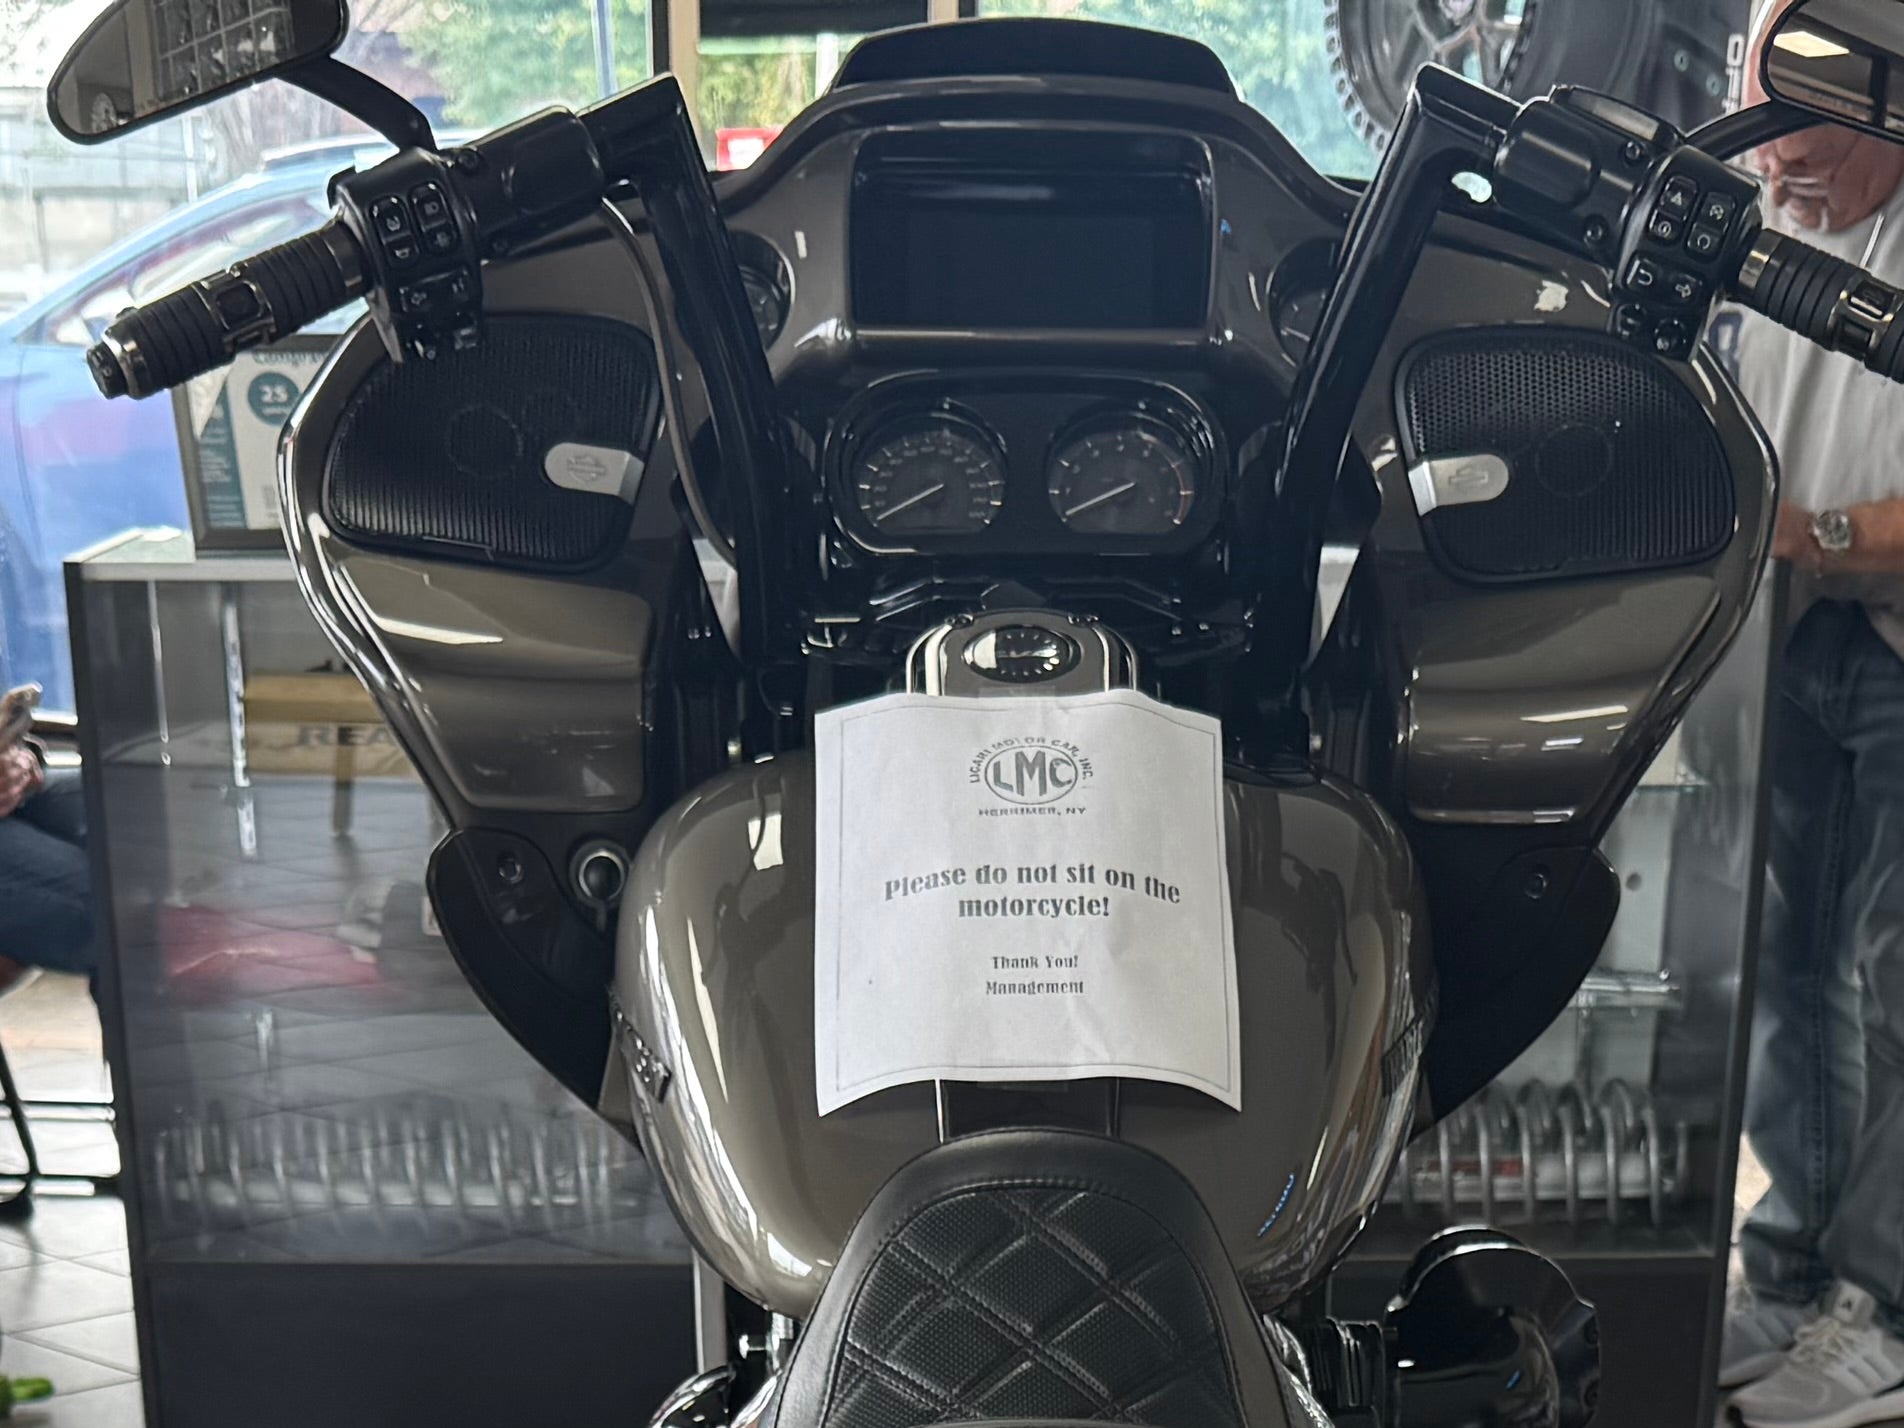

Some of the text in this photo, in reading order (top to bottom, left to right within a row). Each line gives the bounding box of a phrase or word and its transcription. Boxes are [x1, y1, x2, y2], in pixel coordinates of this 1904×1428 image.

[969, 748, 992, 784] LICARI
[992, 750, 1074, 797] LMC
[1065, 807, 1087, 815] NY
[884, 863, 1182, 905] Please do not sit on the
[957, 895, 1111, 920] motorcycle!
[991, 955, 1080, 970] Thank You!
[985, 979, 1086, 997] Management
